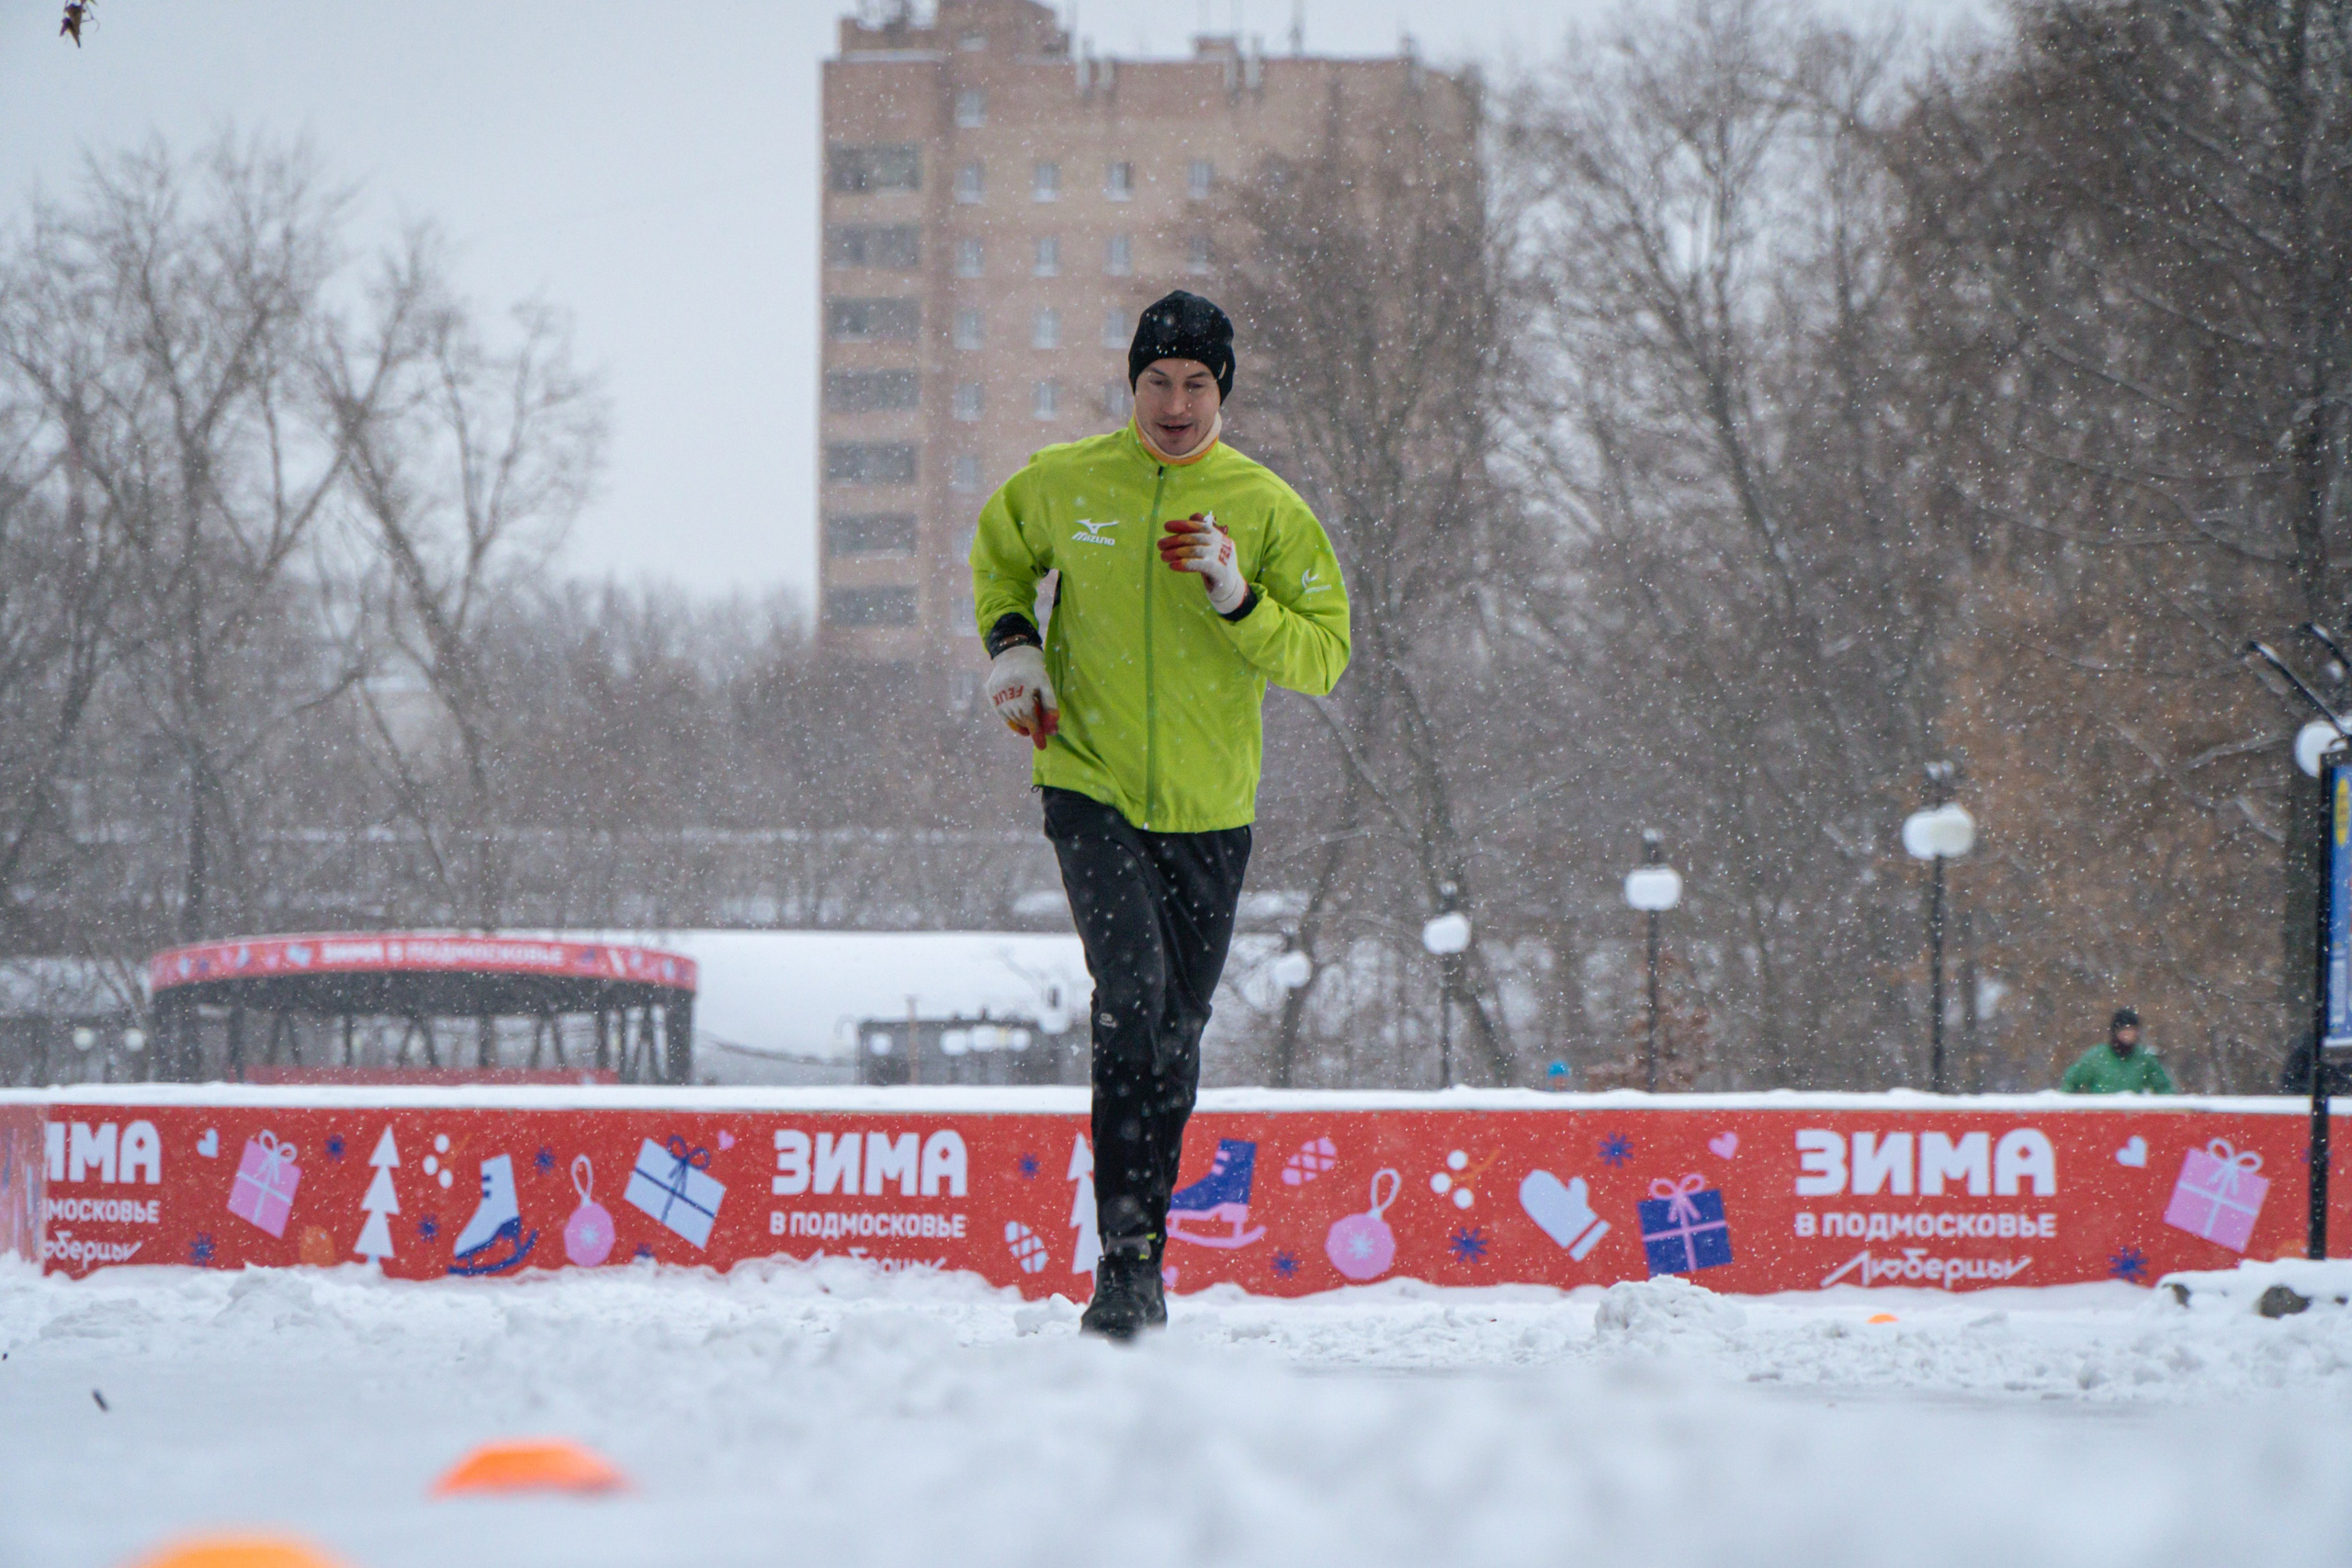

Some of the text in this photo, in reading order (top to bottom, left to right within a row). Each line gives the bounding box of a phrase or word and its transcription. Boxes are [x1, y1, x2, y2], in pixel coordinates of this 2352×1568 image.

[992, 684, 1024, 706] FELIX
[772, 1129, 968, 1197] ЗИМА
[1795, 1128, 2056, 1197] ЗИМА
[42, 1197, 161, 1224] МОСКОВЬЕ
[770, 1211, 967, 1241] В ПОДМОСКОВЬЕ
[1794, 1213, 2057, 1242] В ПОДМОСКОВЬЕ
[1820, 1247, 2032, 1289] Люберцы
